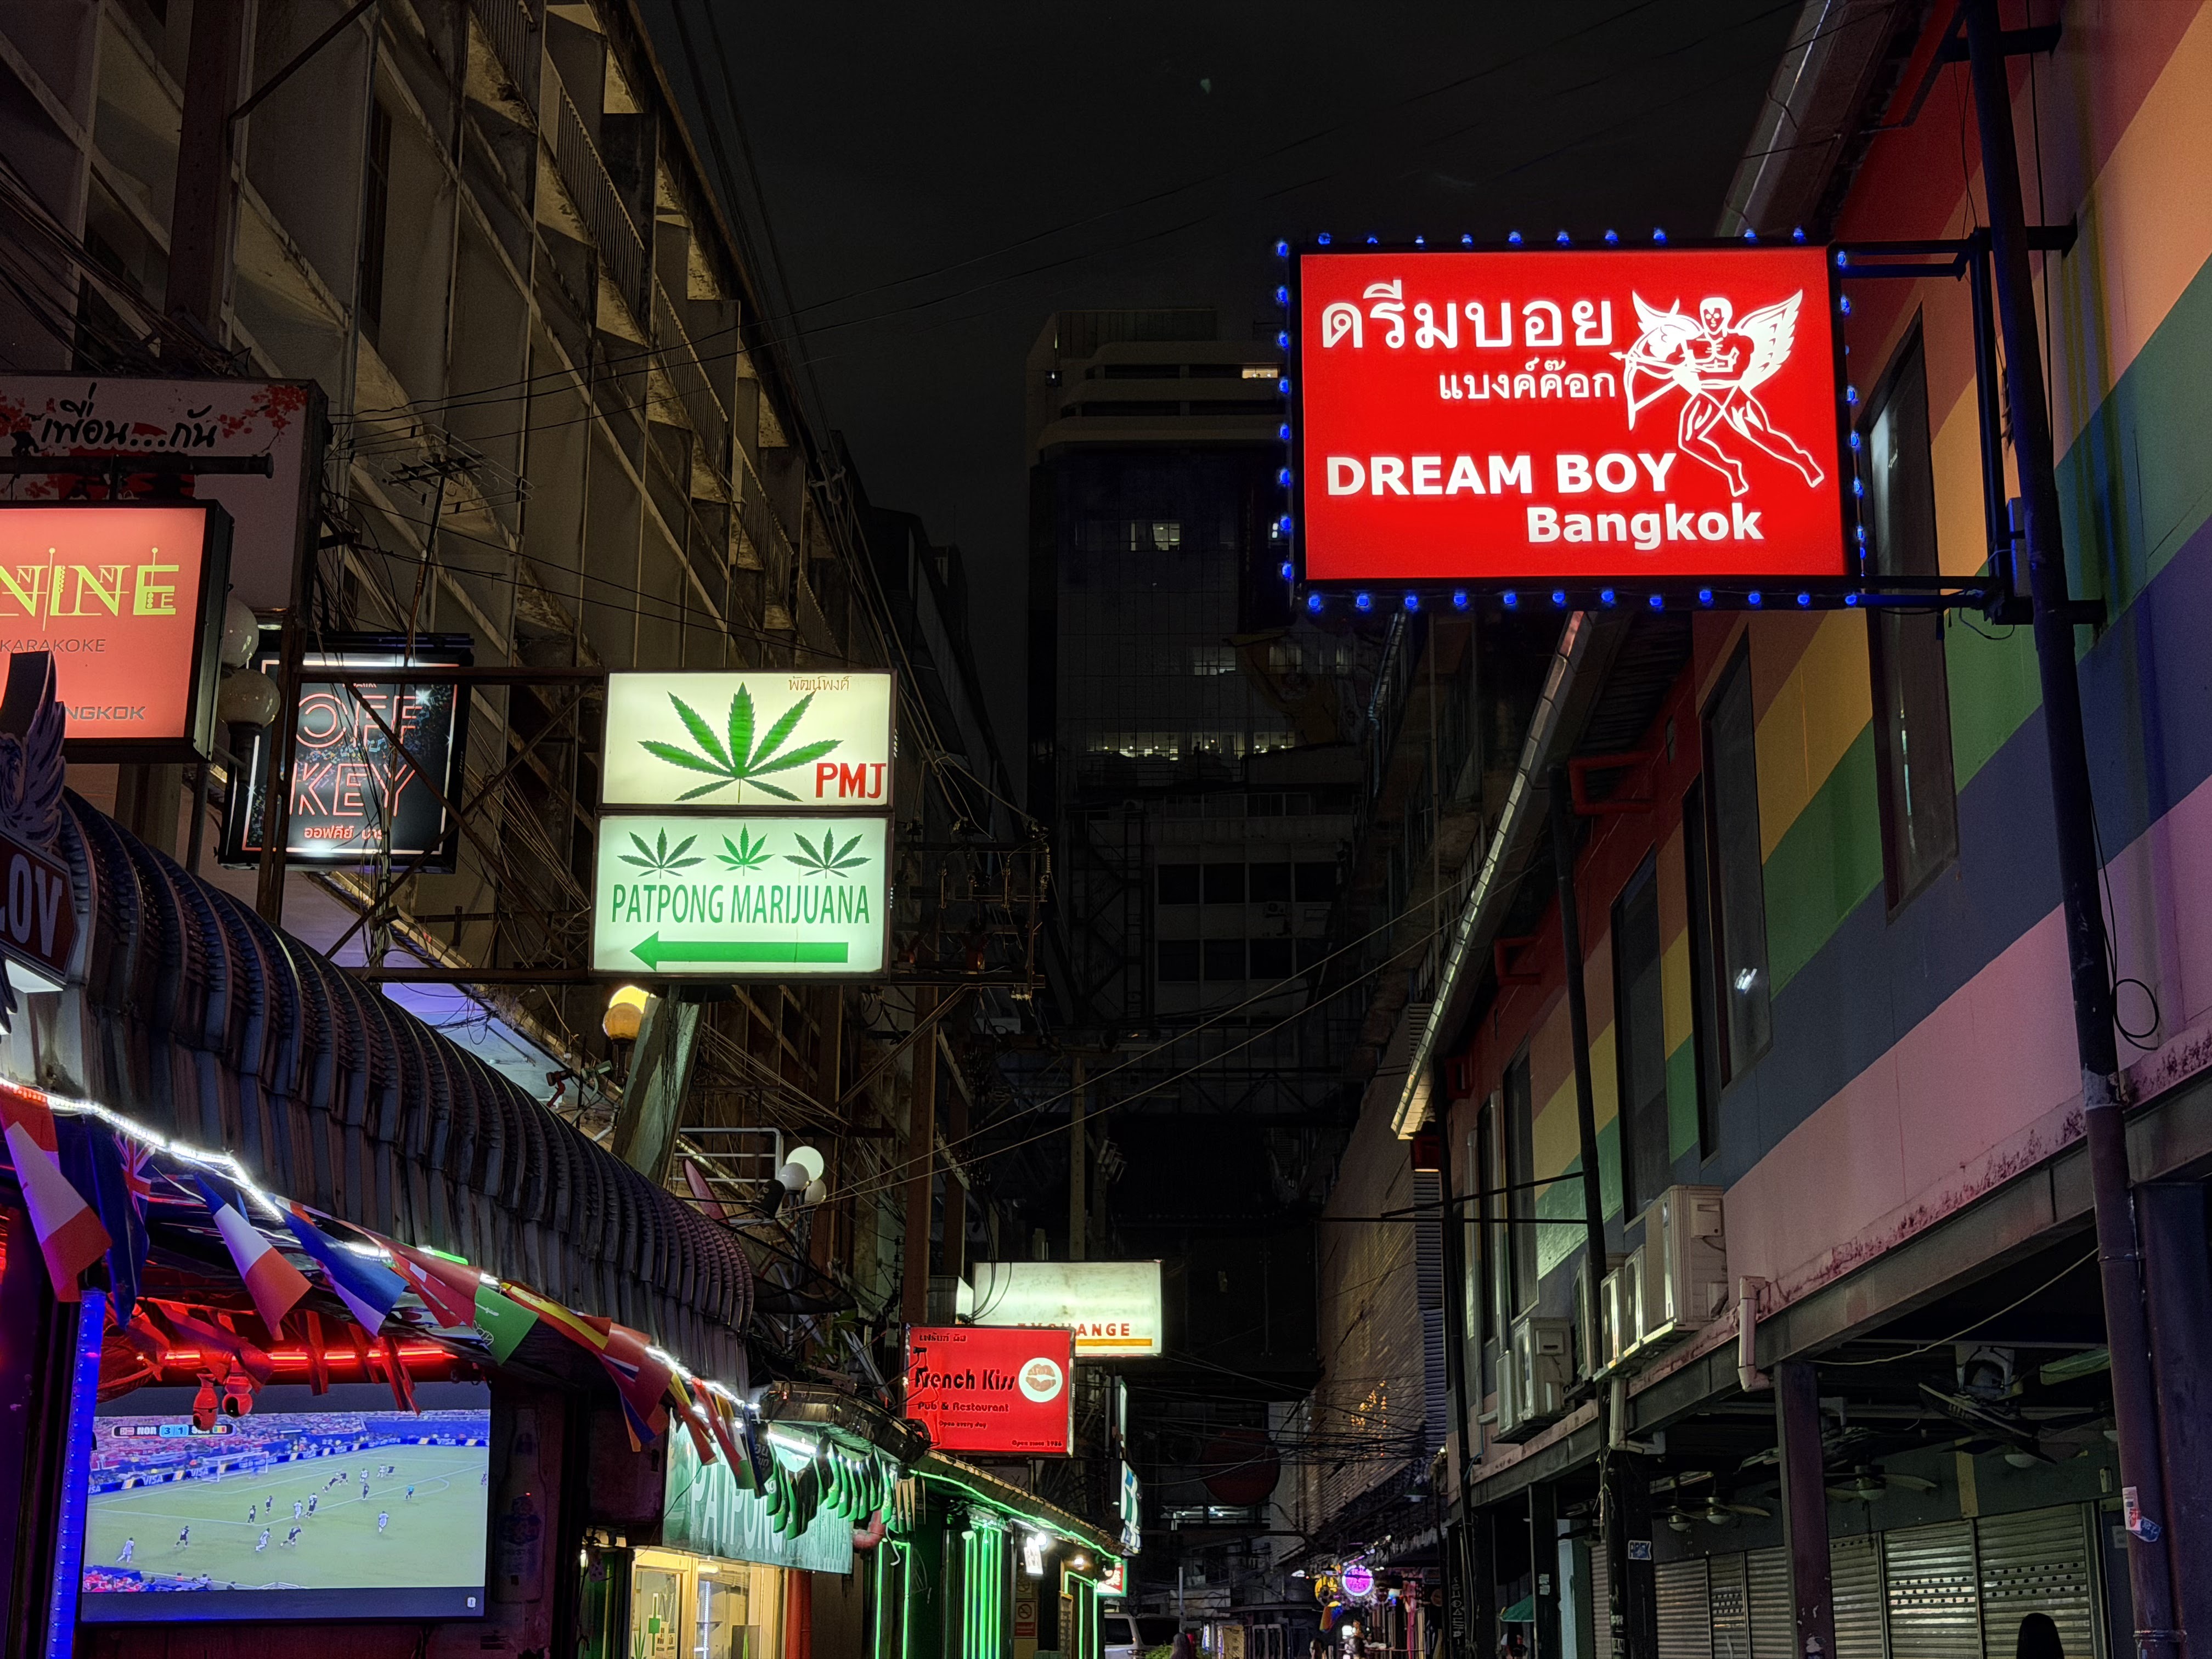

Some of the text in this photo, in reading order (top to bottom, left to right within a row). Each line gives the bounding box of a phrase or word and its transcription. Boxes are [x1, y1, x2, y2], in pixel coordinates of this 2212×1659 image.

[1321, 279, 1613, 349] ดรีมบอย
[1438, 357, 1616, 400] แบงค์ค๊อก
[1326, 452, 1677, 495] DREAM BOY
[1526, 503, 1764, 550] Bangkok
[65, 706, 146, 720] NGKOK
[289, 762, 416, 817] KEY
[815, 763, 887, 799] PMJ
[304, 825, 355, 839] ออฟคีย์
[611, 884, 724, 924] PATPONG
[730, 884, 870, 924] MARIJUANA
[982, 1369, 1015, 1390] Kiss
[918, 1402, 938, 1410] Pub
[952, 1402, 1009, 1412] Restaurant
[137, 1426, 157, 1435] NOR
